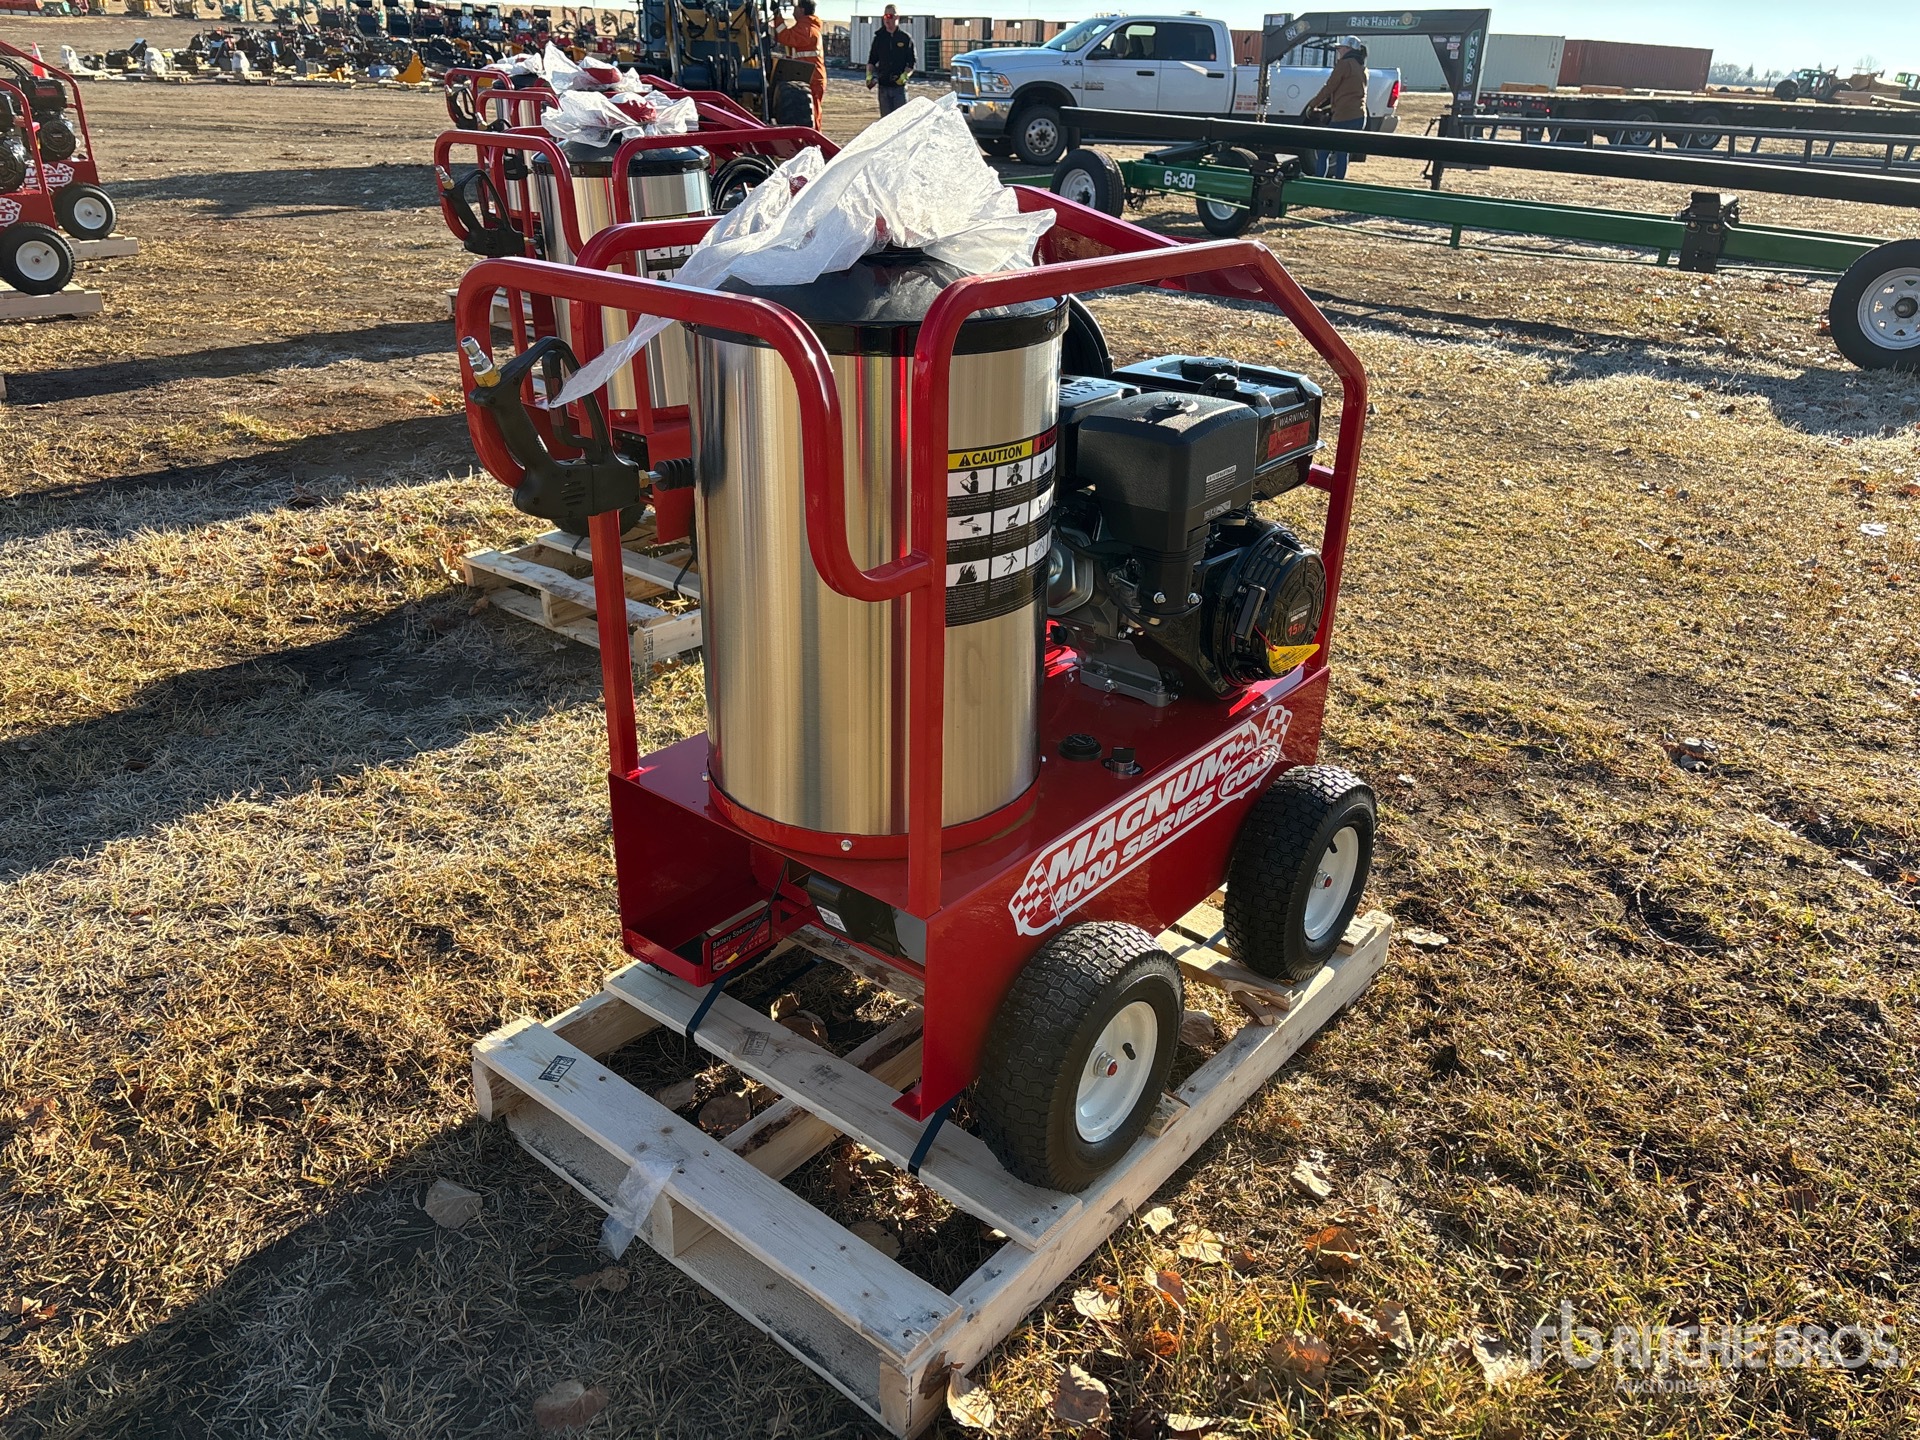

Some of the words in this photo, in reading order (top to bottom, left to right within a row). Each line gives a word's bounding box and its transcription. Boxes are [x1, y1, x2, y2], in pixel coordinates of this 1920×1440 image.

[1351, 16, 1370, 27] Bale
[1371, 15, 1400, 27] Hauler
[1279, 409, 1310, 427] WARNING
[972, 445, 1023, 465] CAUTION
[1049, 729, 1251, 886] MAGNUM
[1050, 850, 1118, 912] 4000
[1119, 785, 1216, 866] SERIES
[712, 934, 732, 950] Battery
